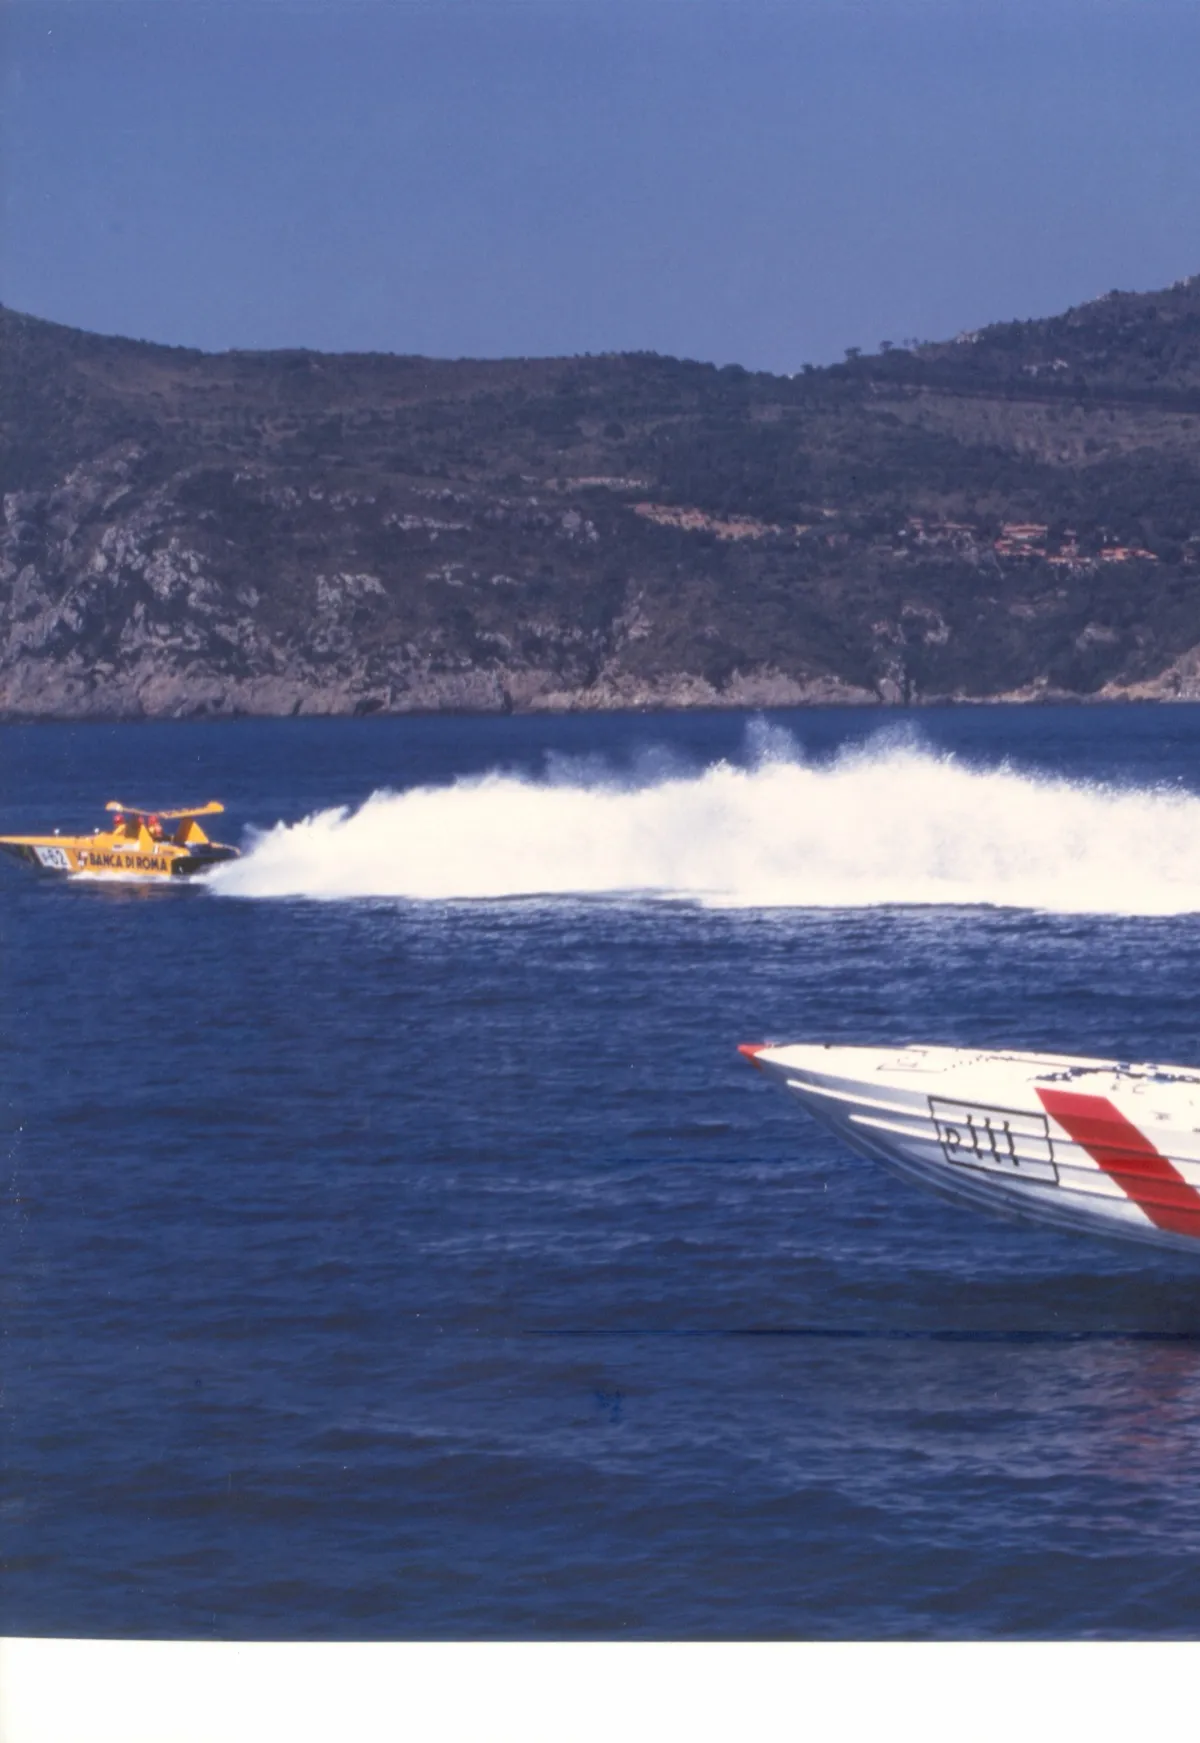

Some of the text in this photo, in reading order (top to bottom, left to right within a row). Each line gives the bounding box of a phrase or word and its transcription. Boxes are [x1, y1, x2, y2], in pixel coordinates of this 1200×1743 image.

[89, 852, 168, 871] BANCA DI ROMA
